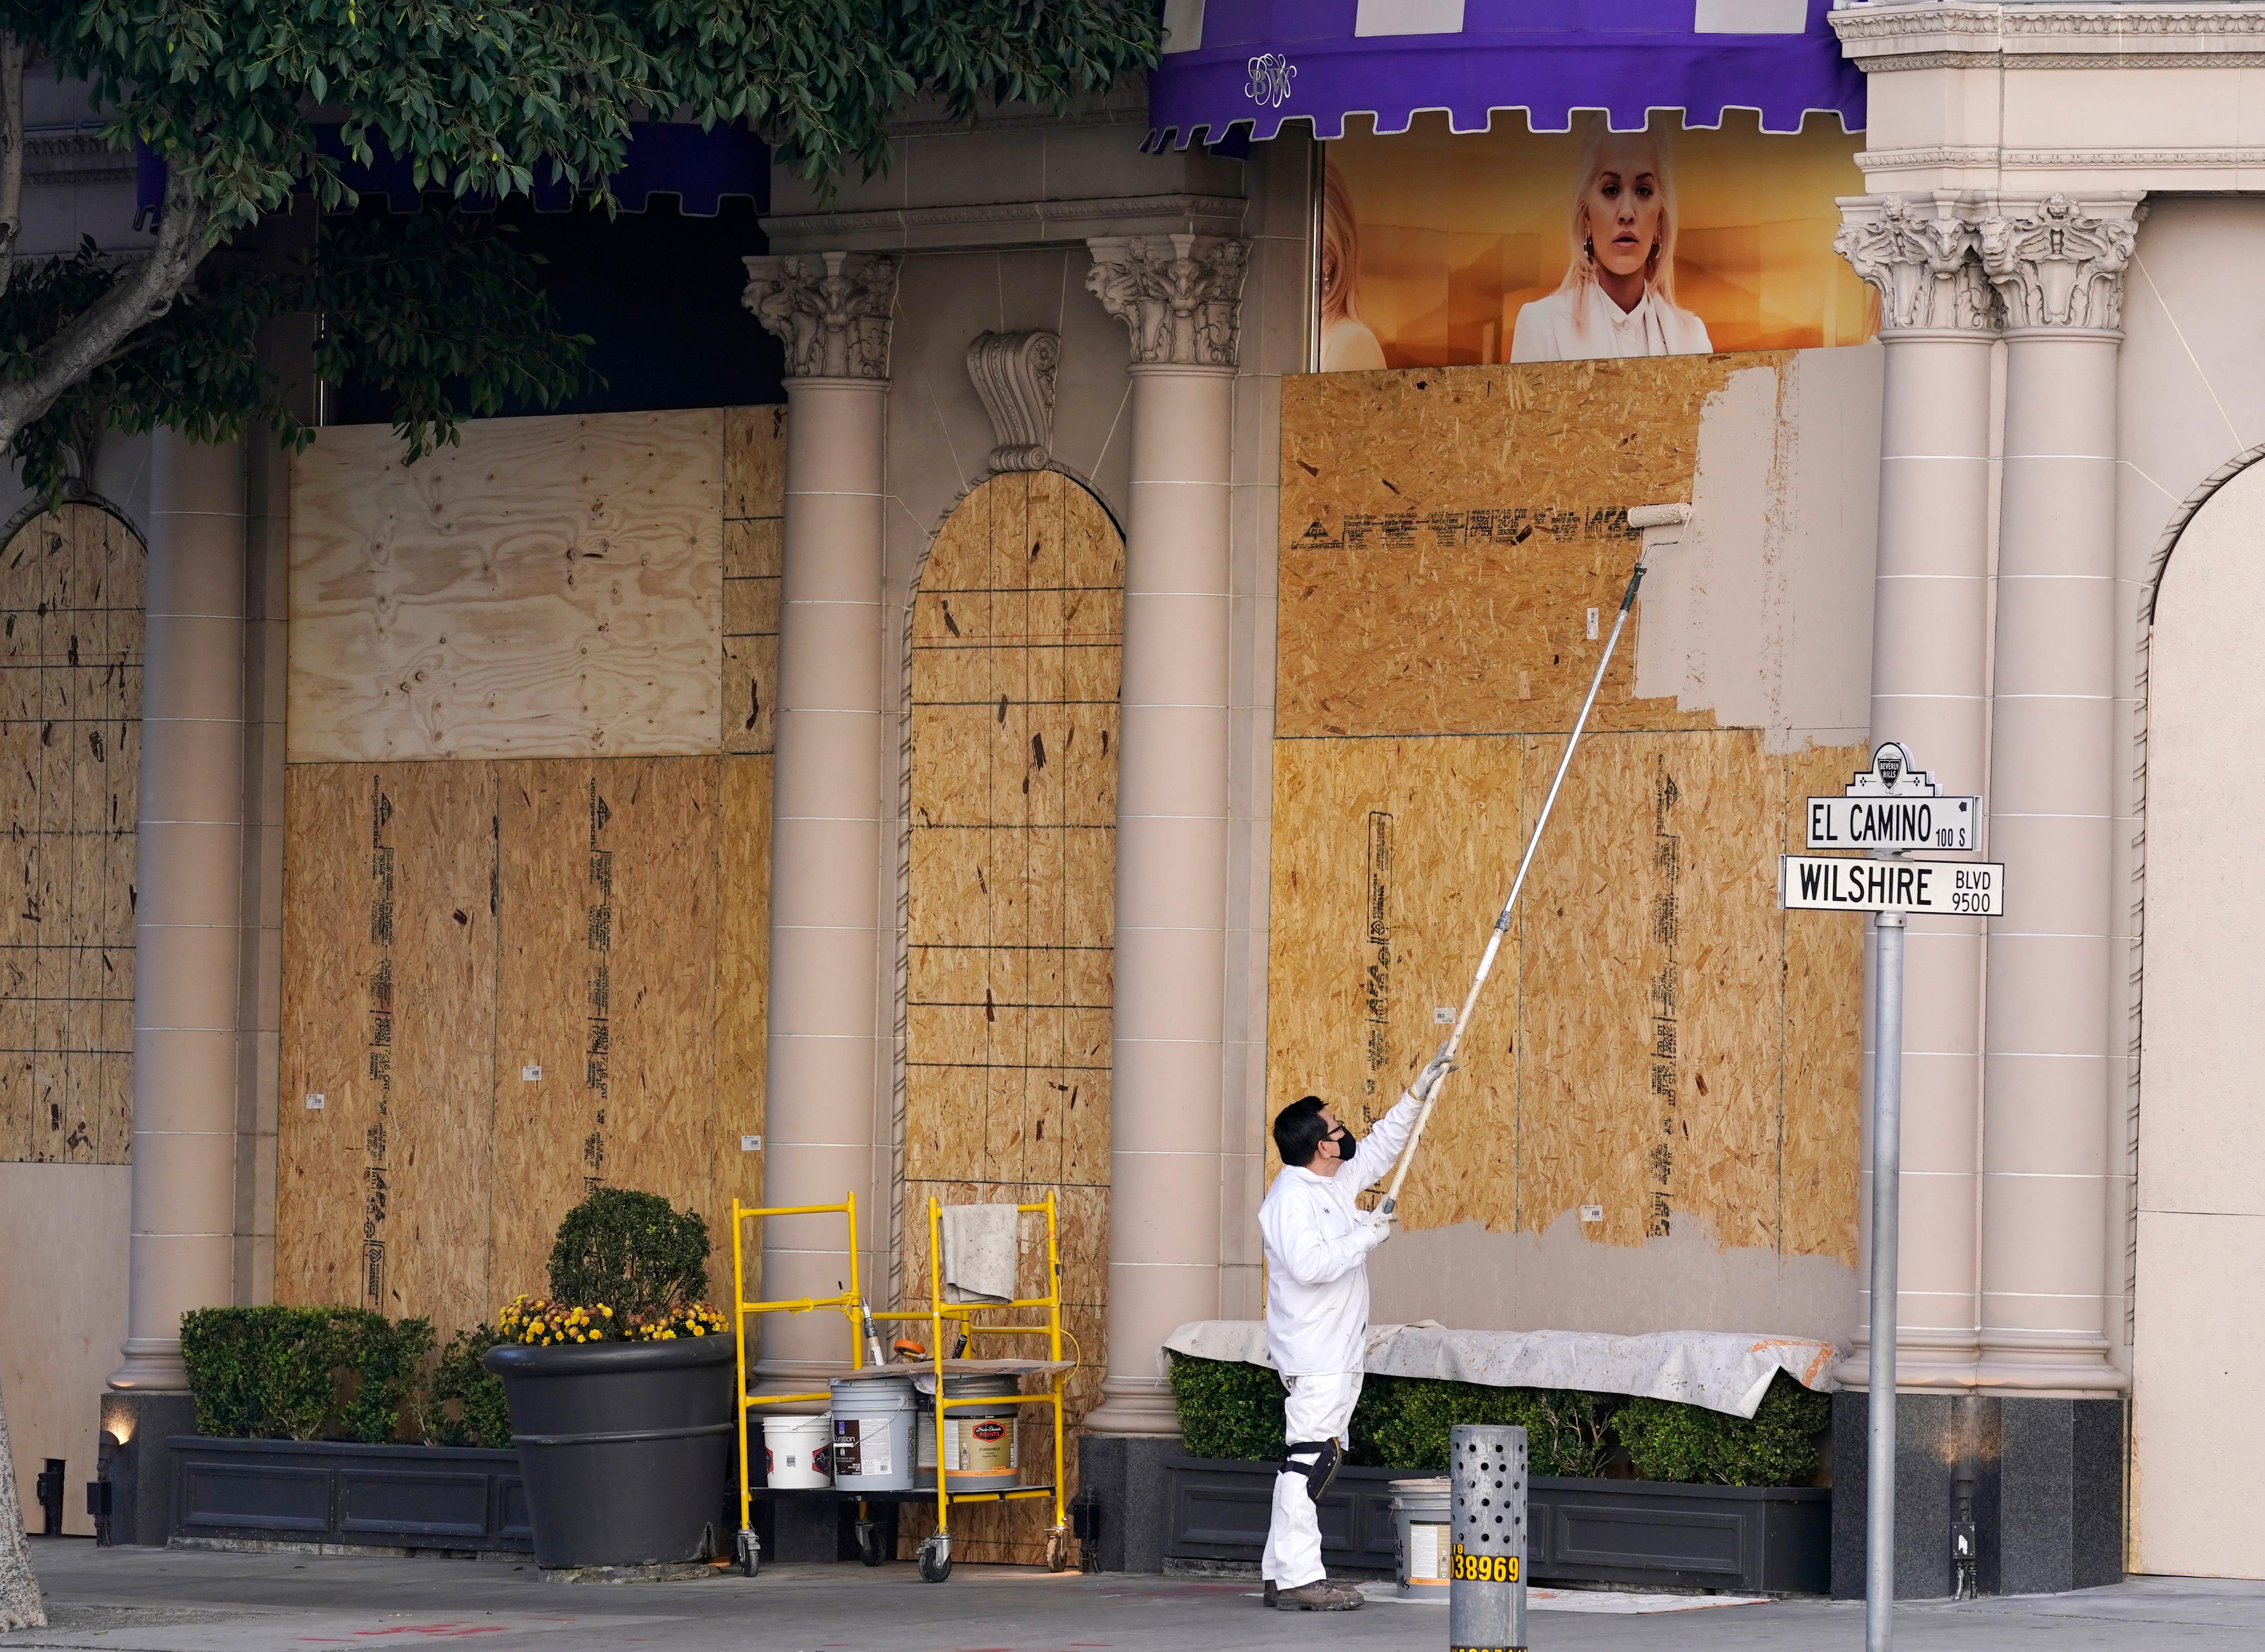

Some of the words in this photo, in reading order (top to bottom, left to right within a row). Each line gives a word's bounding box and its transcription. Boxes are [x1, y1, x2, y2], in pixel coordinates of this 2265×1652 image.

[1812, 804, 1838, 840] EL
[1850, 804, 1932, 841] CAMINO
[1936, 828, 1953, 847] 100
[1959, 827, 1965, 847] S
[1800, 863, 1933, 905] WILSHIRE
[1956, 870, 1991, 890] BLVD
[1952, 893, 1990, 912] 9500
